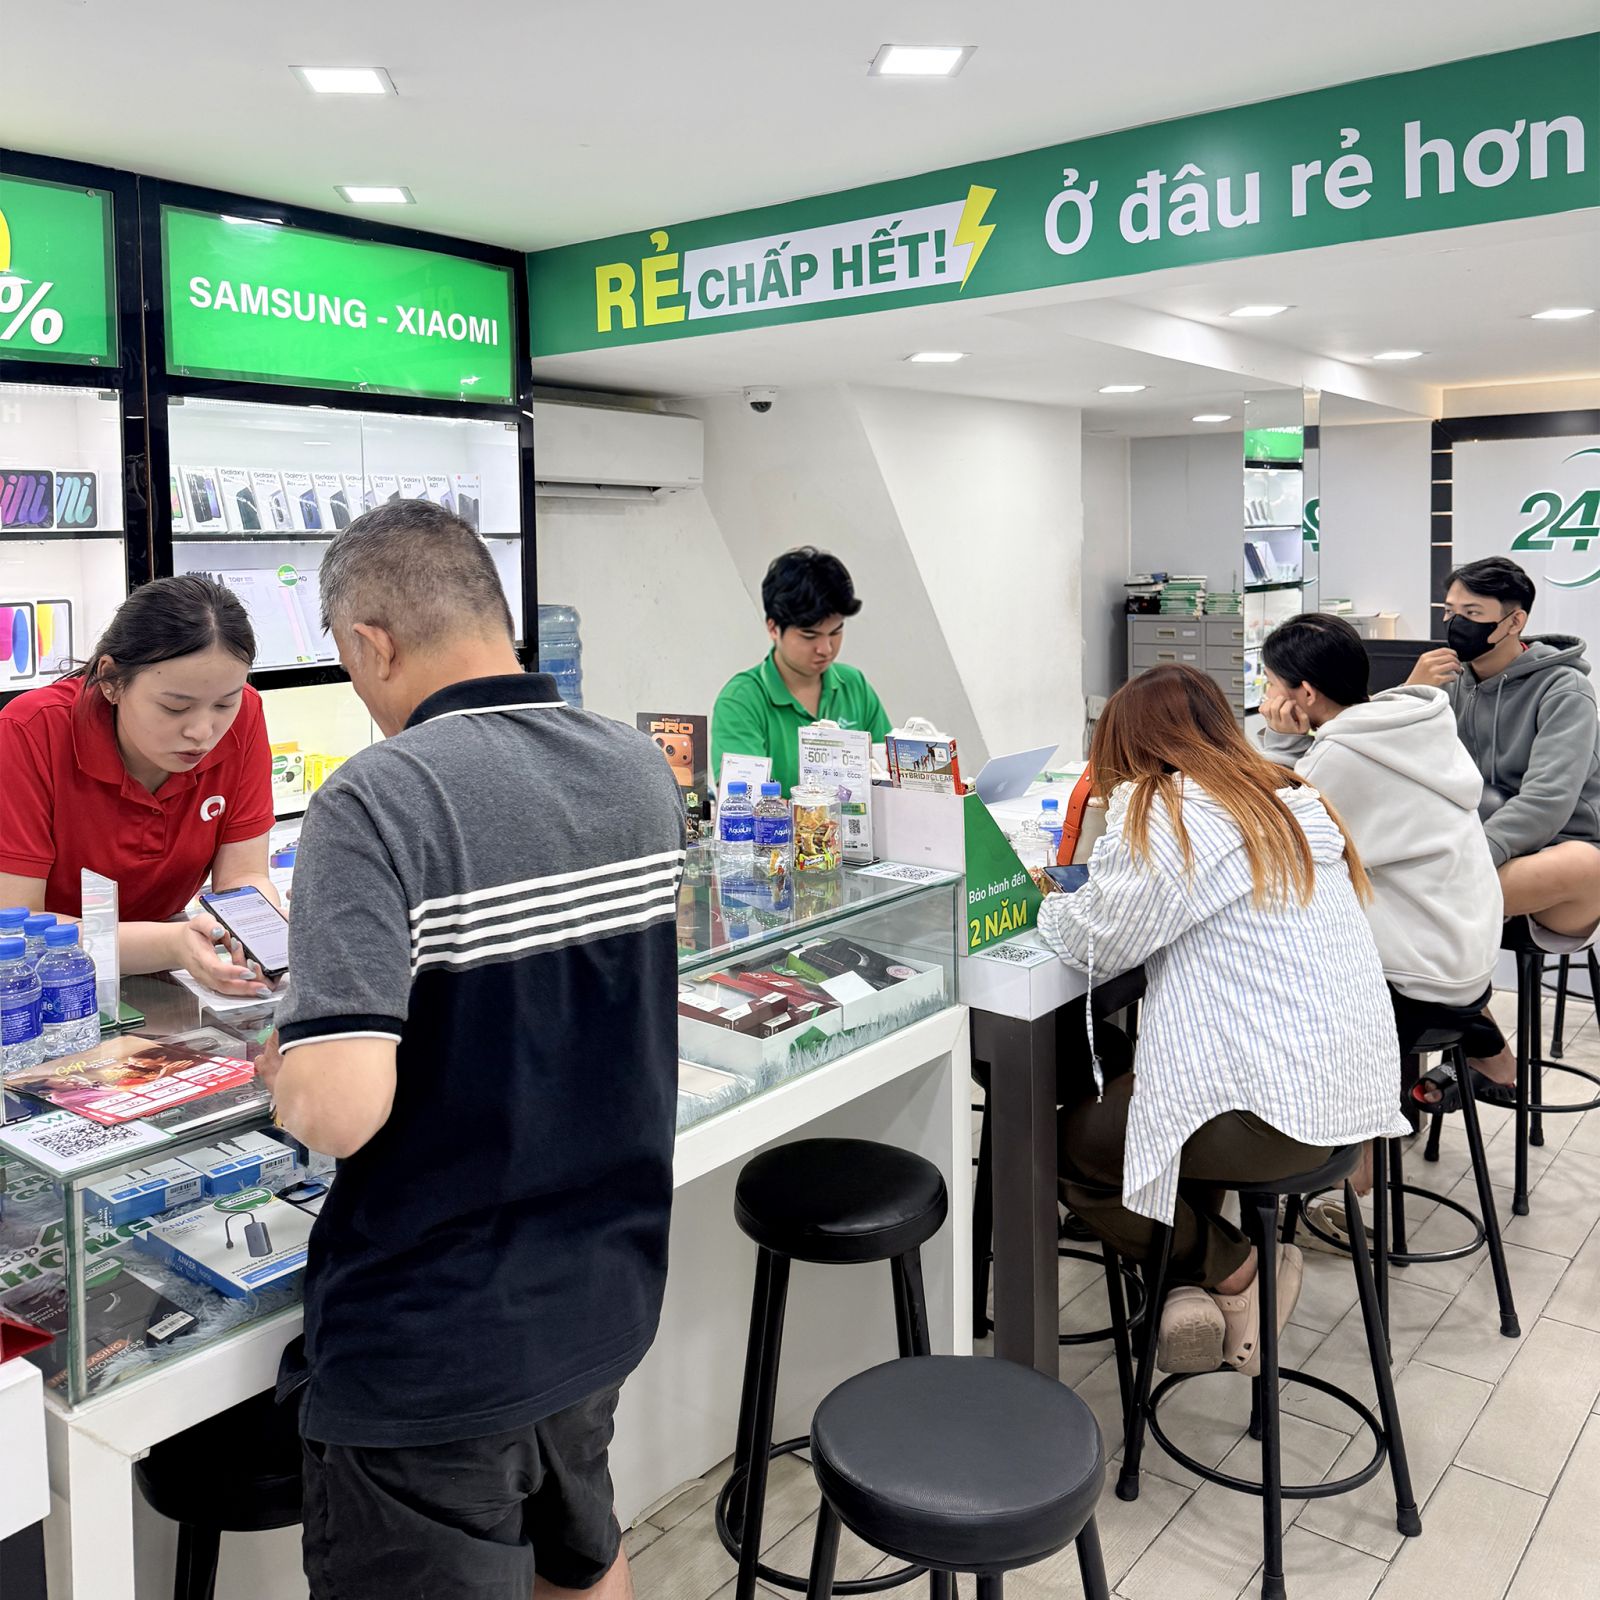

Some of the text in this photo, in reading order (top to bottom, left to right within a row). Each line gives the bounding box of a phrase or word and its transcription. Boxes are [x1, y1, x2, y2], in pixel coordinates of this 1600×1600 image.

[1044, 115, 1586, 255] Ở đâu rẻ hơn
[595, 219, 948, 333] RẺ CHẤP HẾT!
[189, 276, 367, 329] SAMSUNG
[396, 305, 499, 346] XIAOMI
[650, 721, 694, 735] PRO
[969, 870, 1027, 904] Bảo hành đến
[970, 898, 1028, 948] 2 NĂM
[162, 1214, 205, 1233] ANKER
